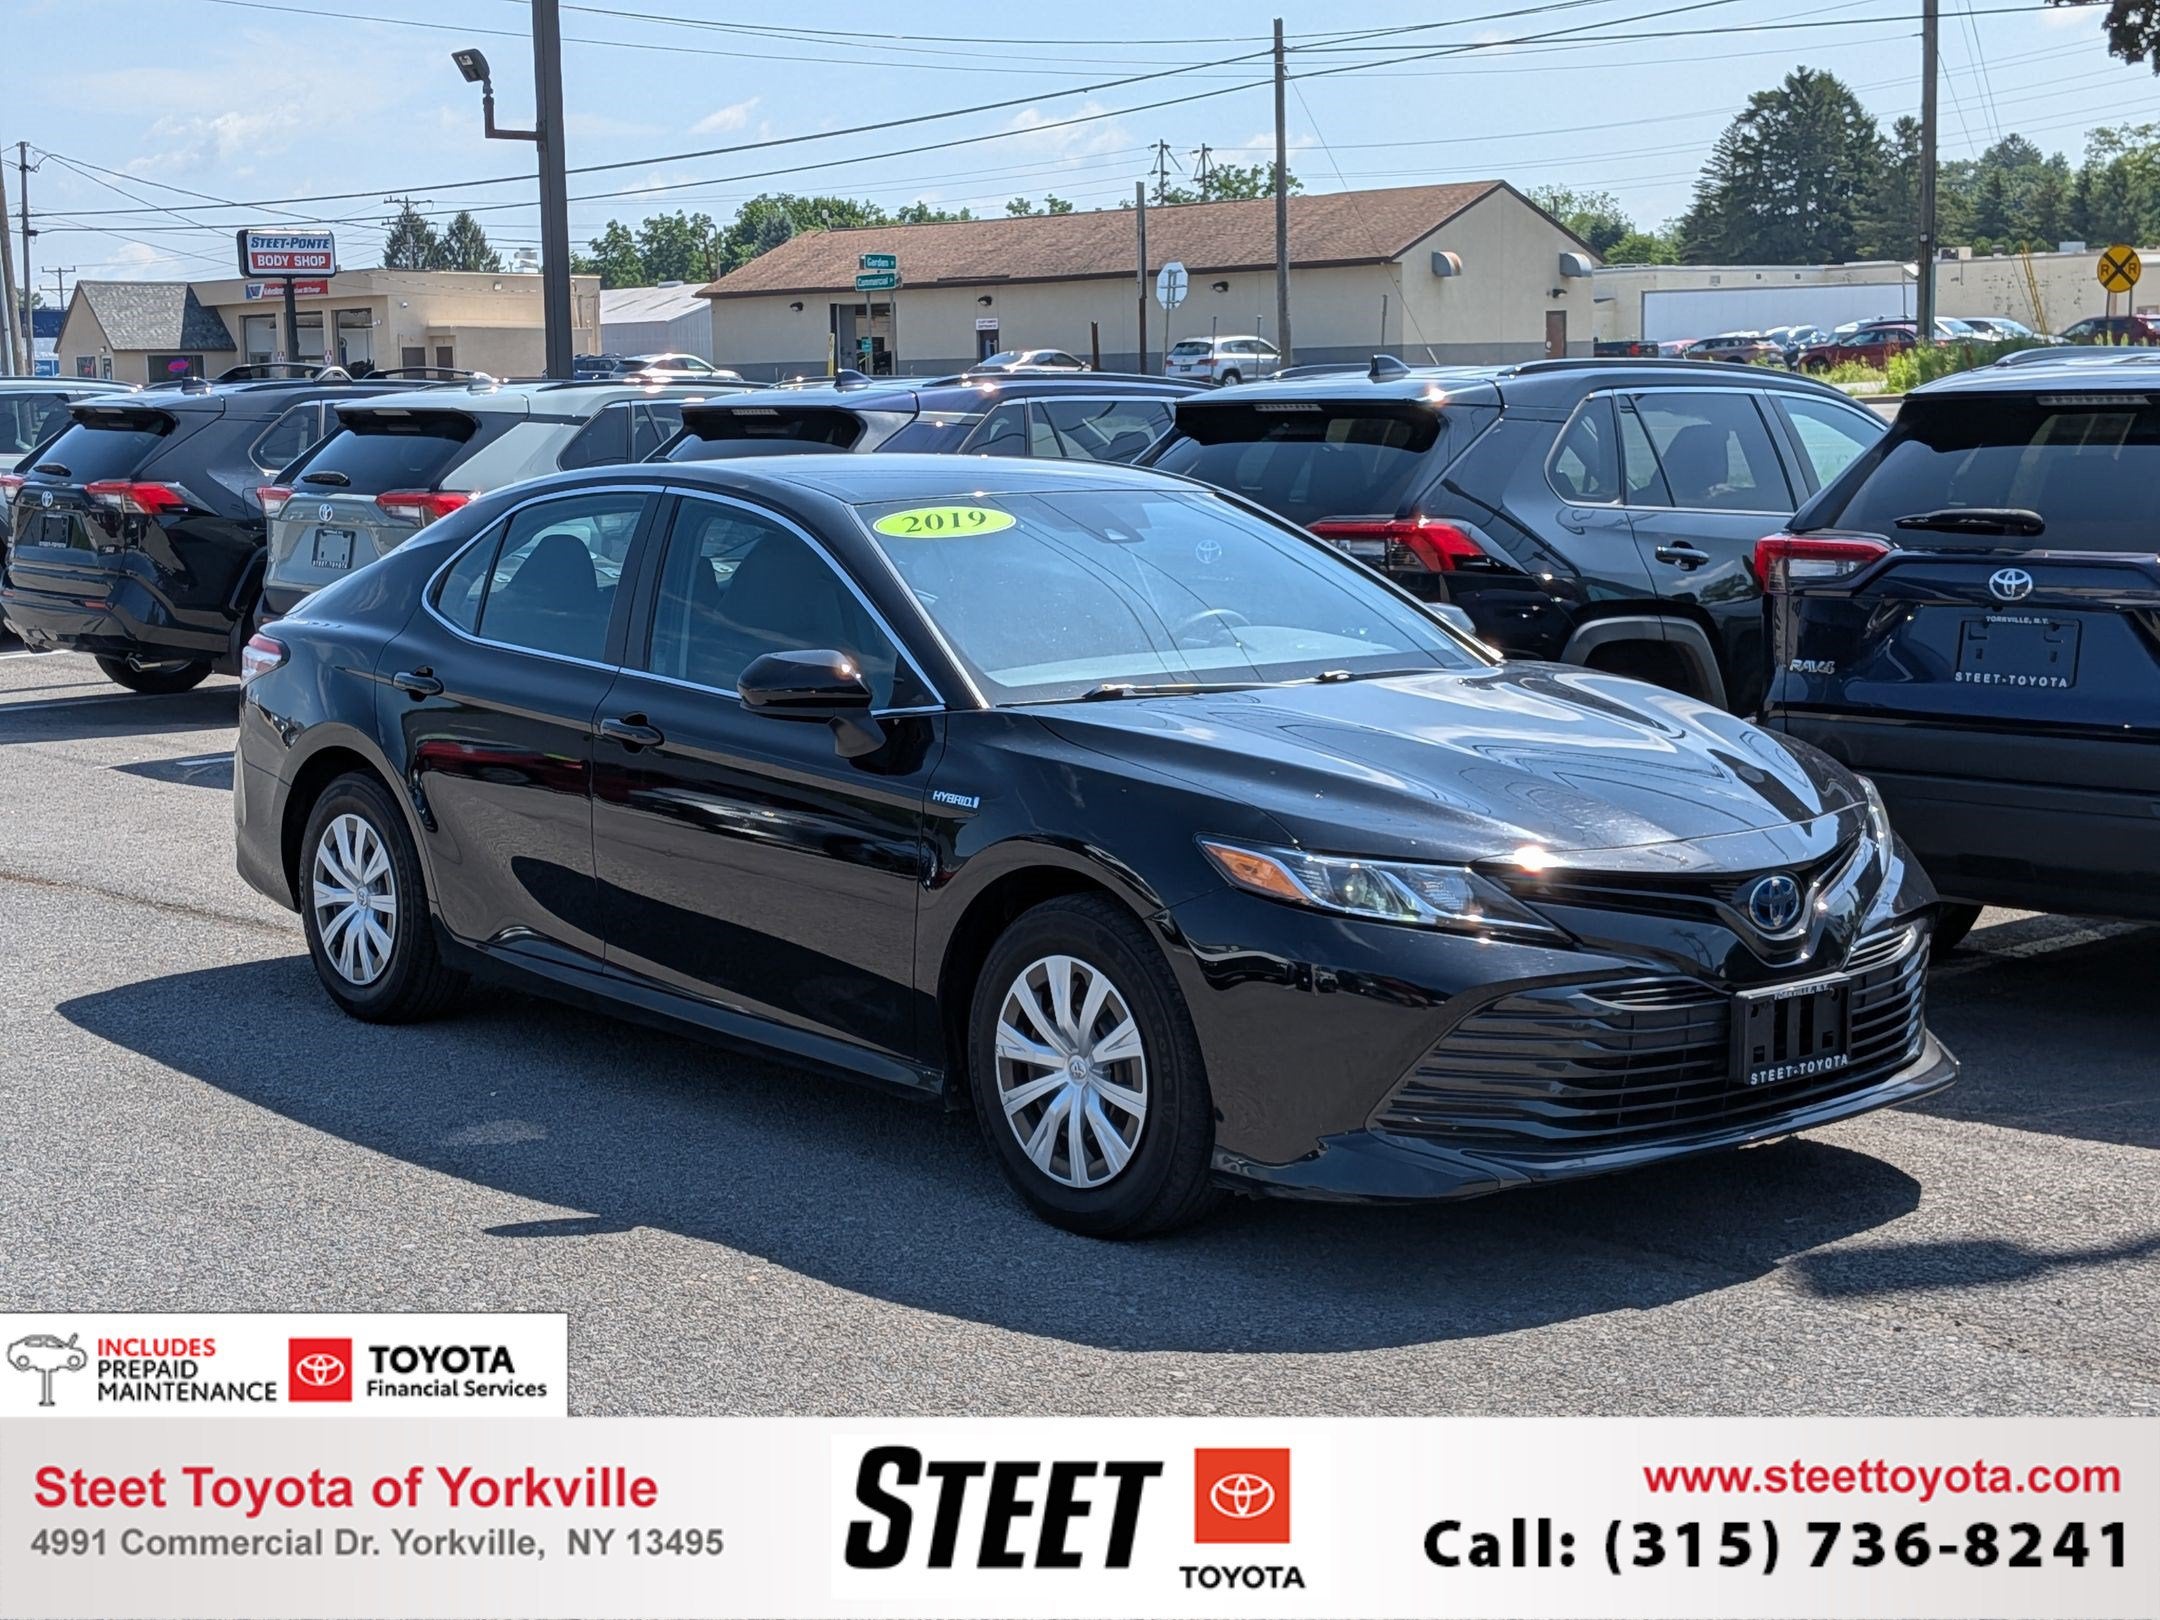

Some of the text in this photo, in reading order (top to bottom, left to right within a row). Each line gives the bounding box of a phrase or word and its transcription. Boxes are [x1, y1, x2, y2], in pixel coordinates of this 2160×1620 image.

[251, 237, 330, 249] STEET-PONTE
[257, 255, 326, 267] BODY SHOP
[2101, 263, 2137, 277] R R
[902, 511, 987, 533] 2019
[1955, 671, 2068, 688] STEET-TOYOTA
[932, 790, 973, 808] HYBRID
[1750, 1053, 1849, 1086] STEET-TOYOTA
